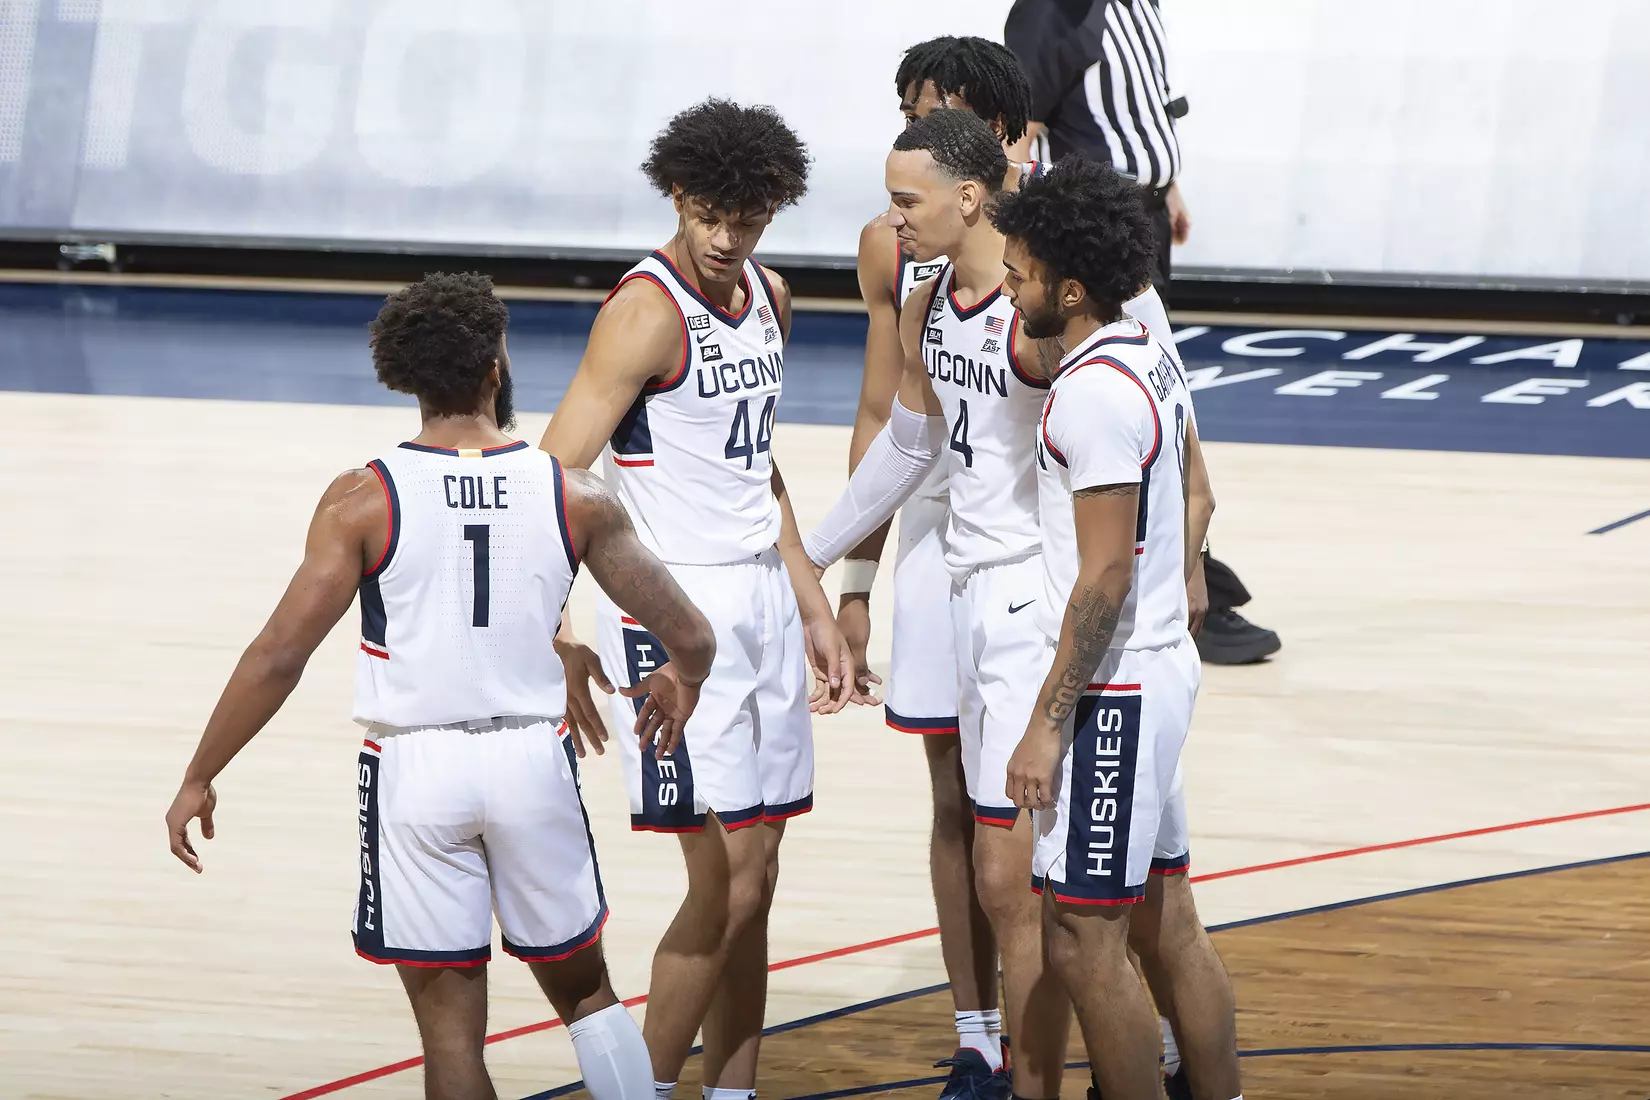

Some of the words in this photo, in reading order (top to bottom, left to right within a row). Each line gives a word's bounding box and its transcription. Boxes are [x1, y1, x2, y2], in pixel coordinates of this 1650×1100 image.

[916, 265, 940, 276] BLM
[689, 315, 709, 329] DEE
[928, 329, 942, 339] BLM
[703, 345, 719, 357] BLM
[981, 344, 1001, 353] EAST
[984, 338, 998, 346] BIG
[924, 348, 1009, 398] UCONN
[724, 395, 773, 471] 44
[950, 398, 974, 468] 4
[443, 475, 509, 509] COLE
[464, 525, 490, 627] 1
[1086, 708, 1123, 876] HUSKIES
